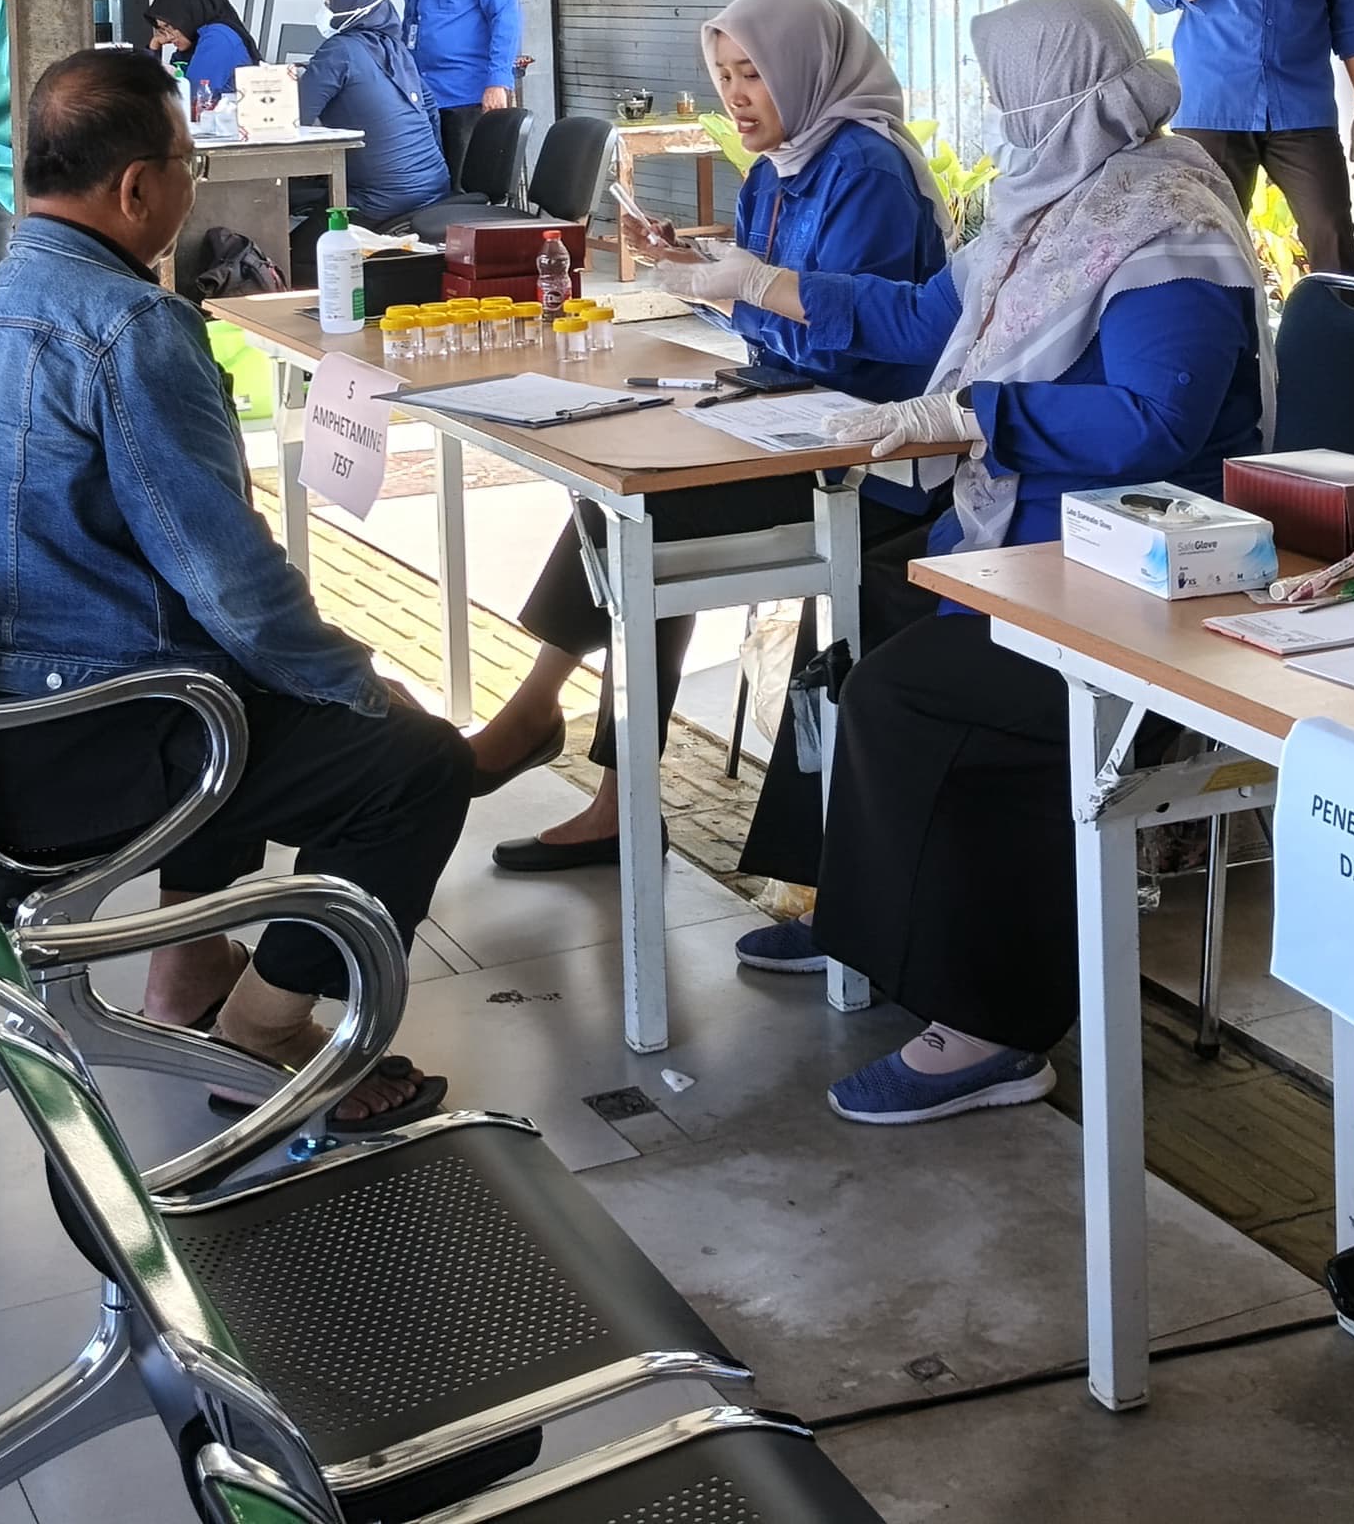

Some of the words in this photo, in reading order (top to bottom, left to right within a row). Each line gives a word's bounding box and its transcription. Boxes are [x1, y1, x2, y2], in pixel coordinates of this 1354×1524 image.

[347, 380, 355, 400] 5
[312, 404, 383, 453] AMPHETAMINE
[332, 452, 354, 479] TEST
